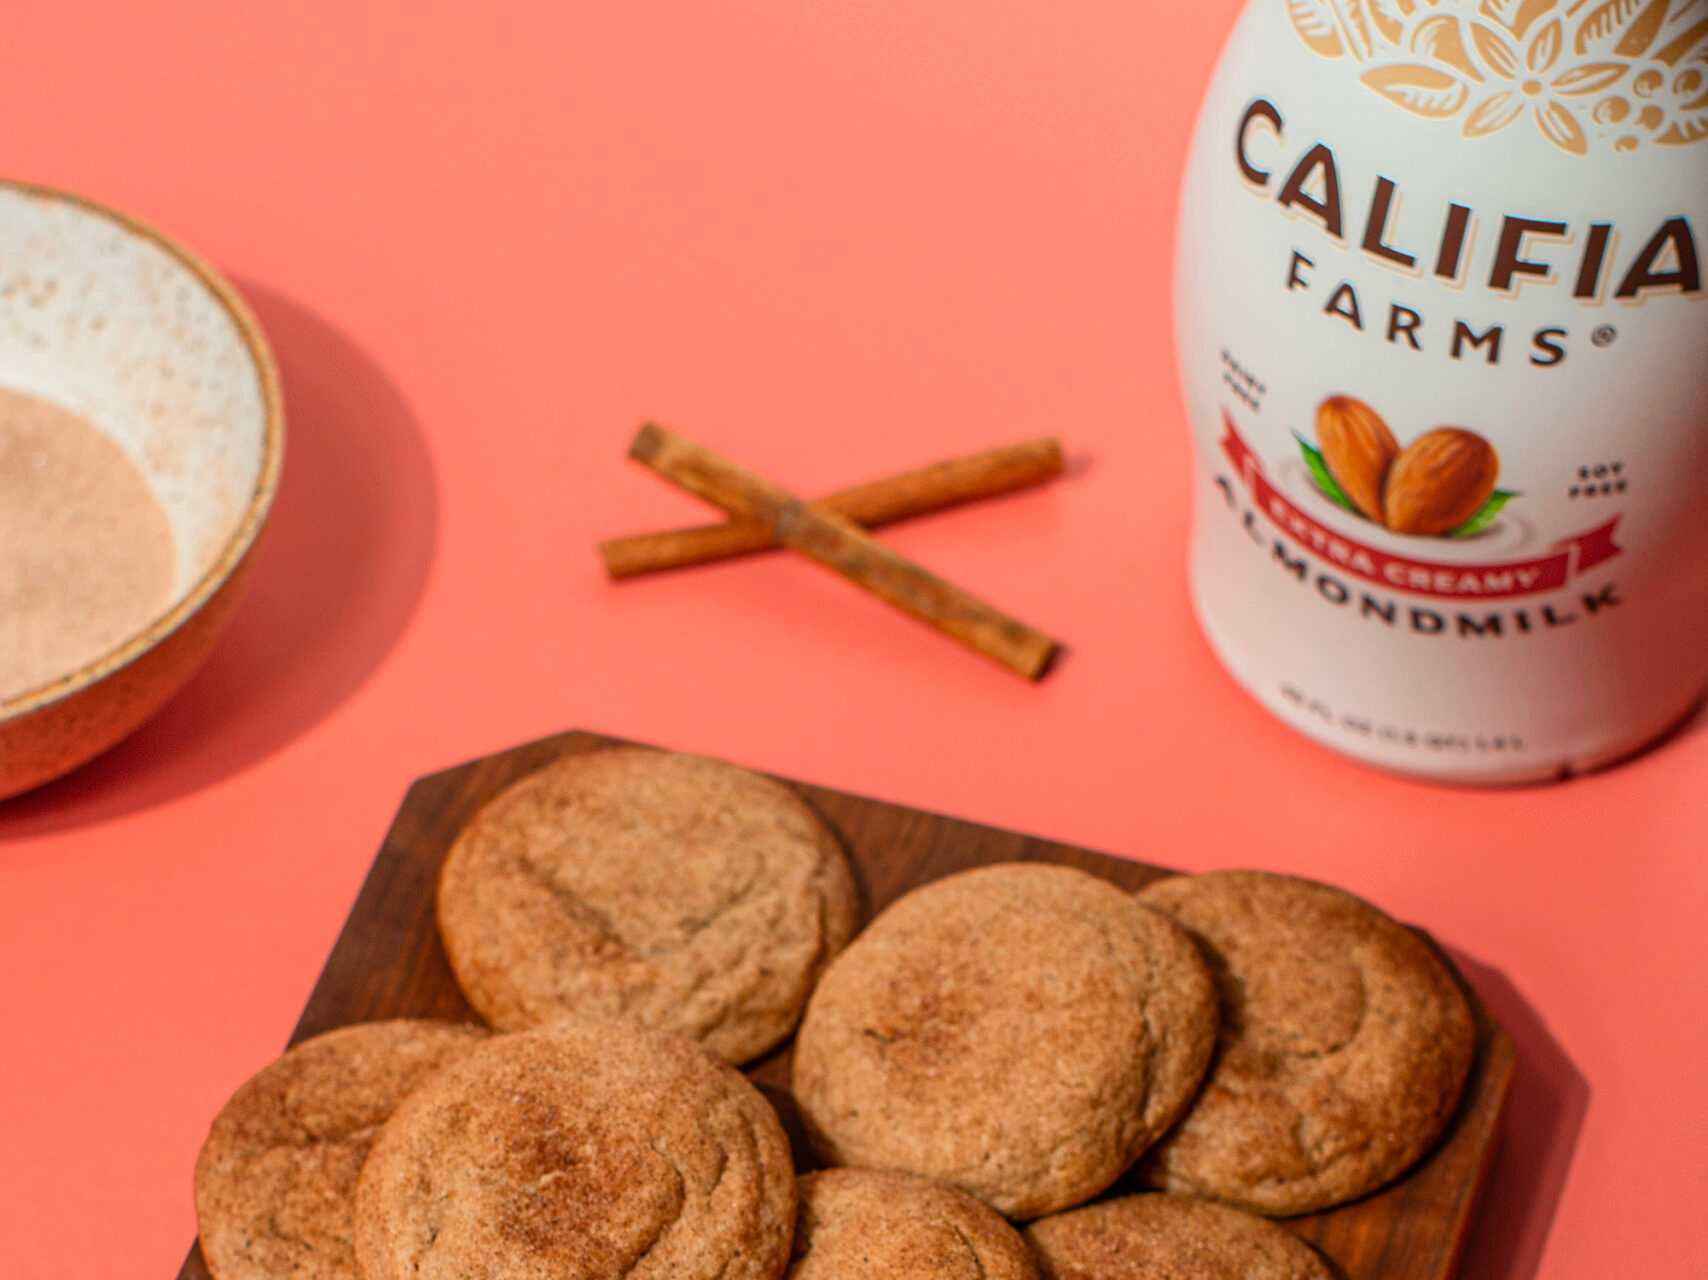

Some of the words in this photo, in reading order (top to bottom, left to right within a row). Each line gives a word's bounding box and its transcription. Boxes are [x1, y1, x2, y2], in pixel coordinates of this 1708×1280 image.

[1234, 96, 1701, 302] CALIFIA
[1215, 473, 1622, 640] ALMONDMILK
[1267, 497, 1375, 578] EXTRA
[1382, 561, 1542, 595] CREAMY
